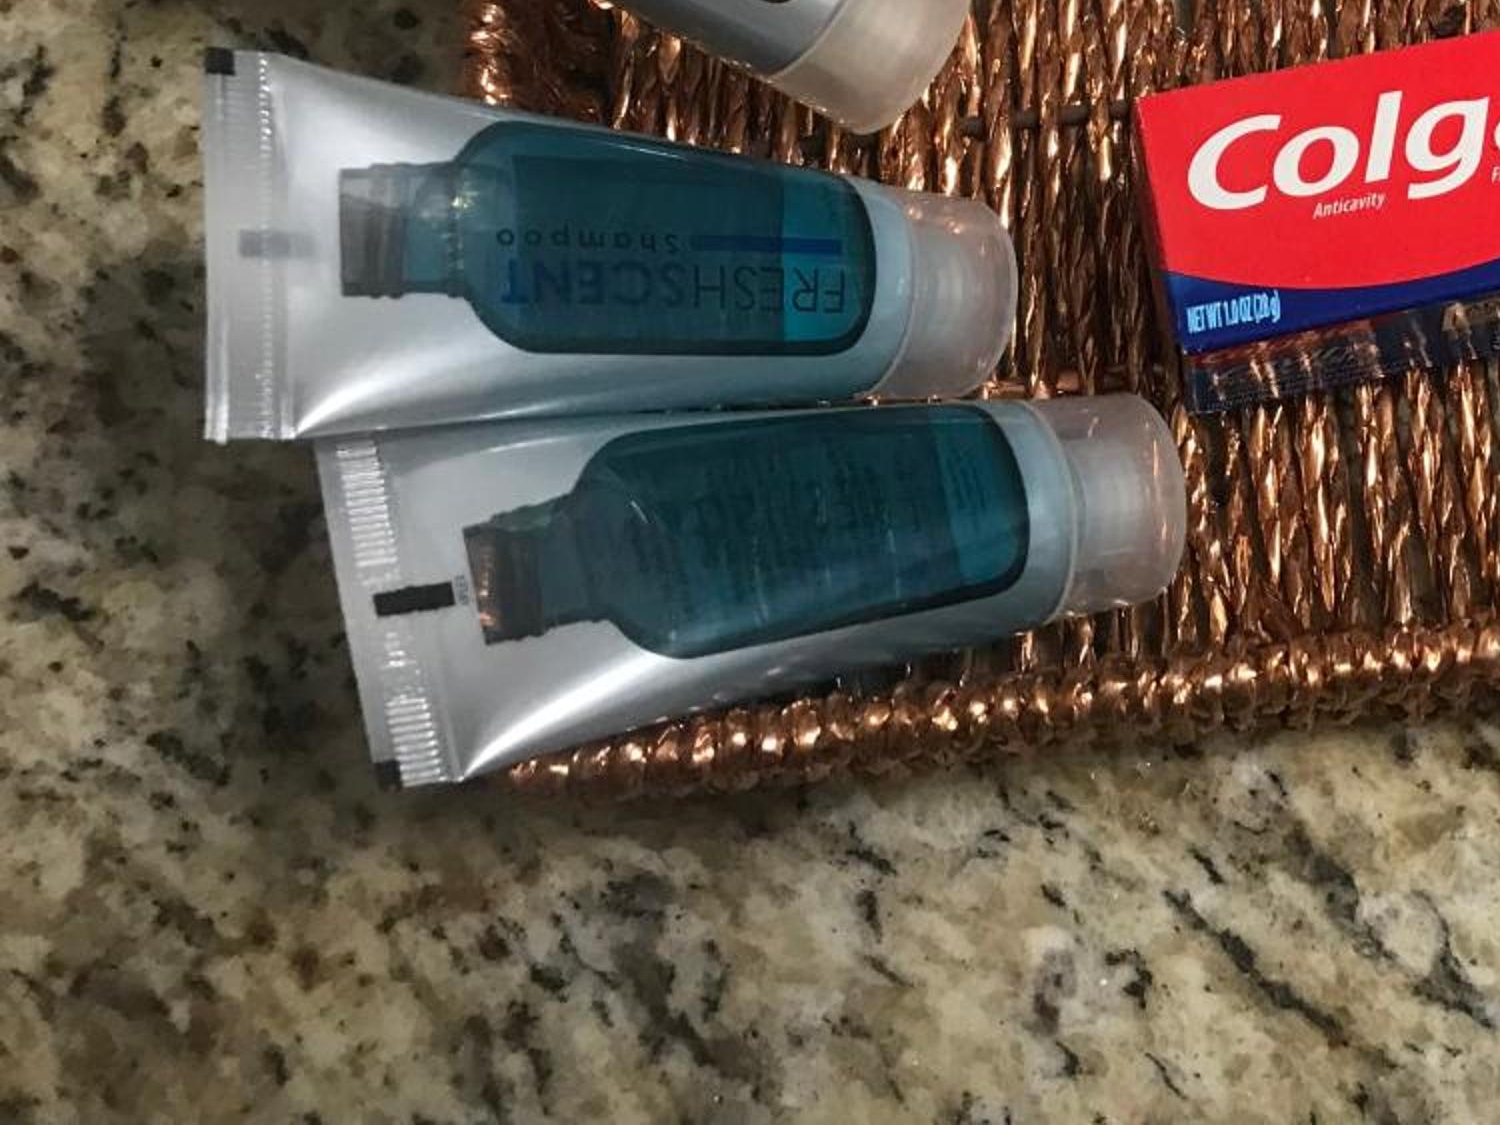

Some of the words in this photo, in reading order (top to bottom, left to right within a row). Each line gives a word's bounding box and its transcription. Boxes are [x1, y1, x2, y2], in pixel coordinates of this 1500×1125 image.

[1312, 191, 1388, 220] Anticavity
[496, 225, 678, 255] Shampoo
[500, 258, 846, 315] FRESHSCENT
[1186, 304, 1205, 334] NET
[1205, 301, 1222, 330] WT
